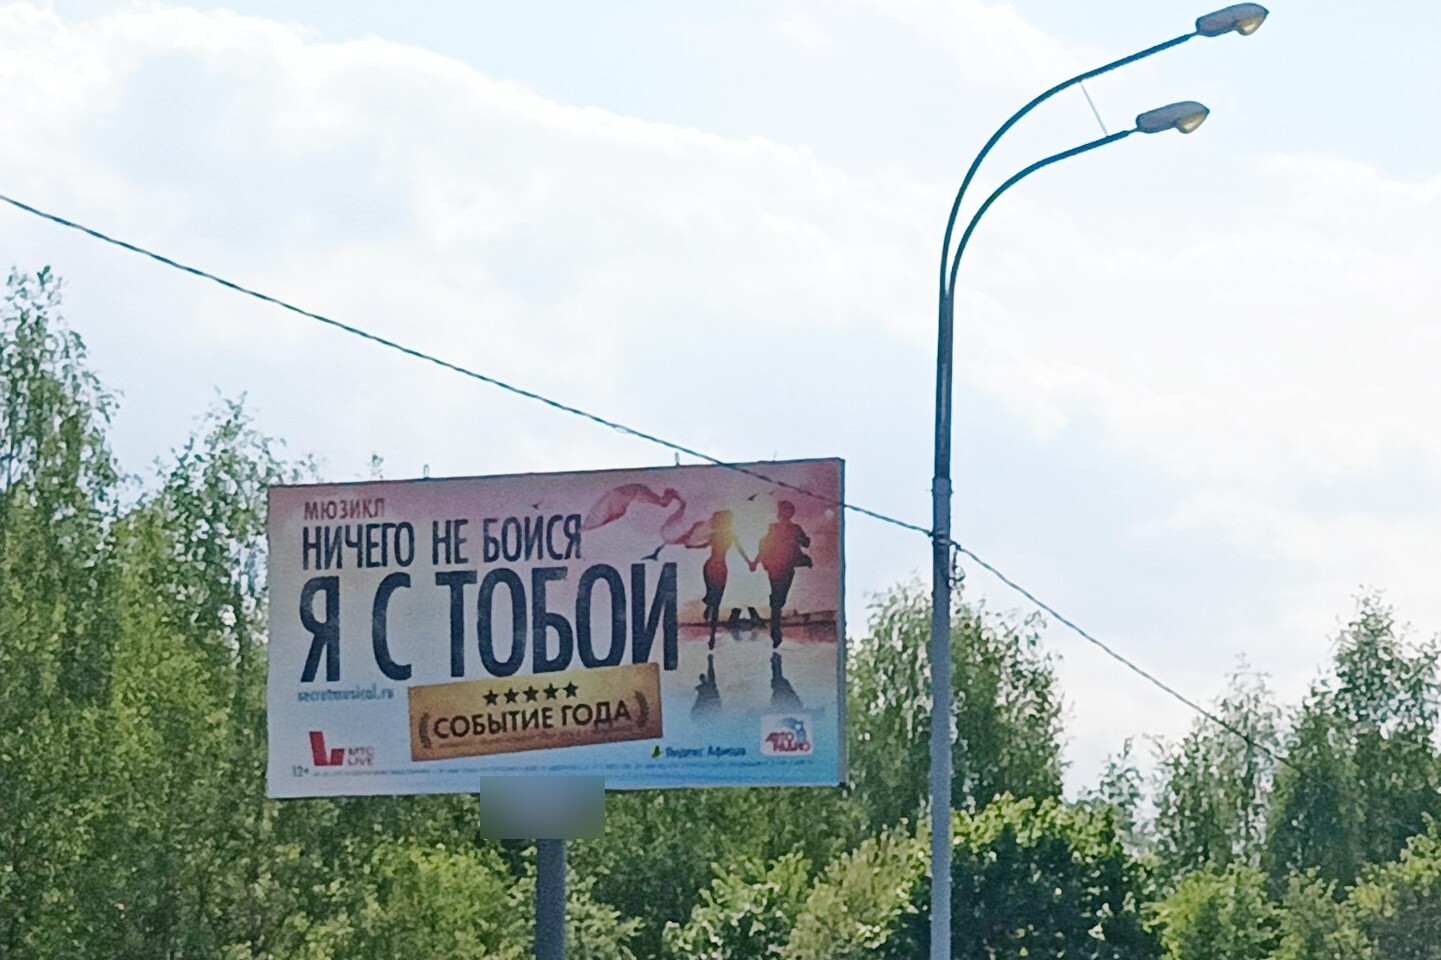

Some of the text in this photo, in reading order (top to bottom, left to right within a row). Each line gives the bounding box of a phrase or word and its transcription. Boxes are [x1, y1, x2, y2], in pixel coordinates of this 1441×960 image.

[304, 498, 385, 520] МЮЗИКЛ
[303, 502, 582, 570] НИЧЕГО НЕ БОЙСЯ
[300, 546, 678, 682] Я С ТОБОЙ
[433, 706, 554, 739] СОБЫТИЕ
[561, 700, 633, 730] ГОДА
